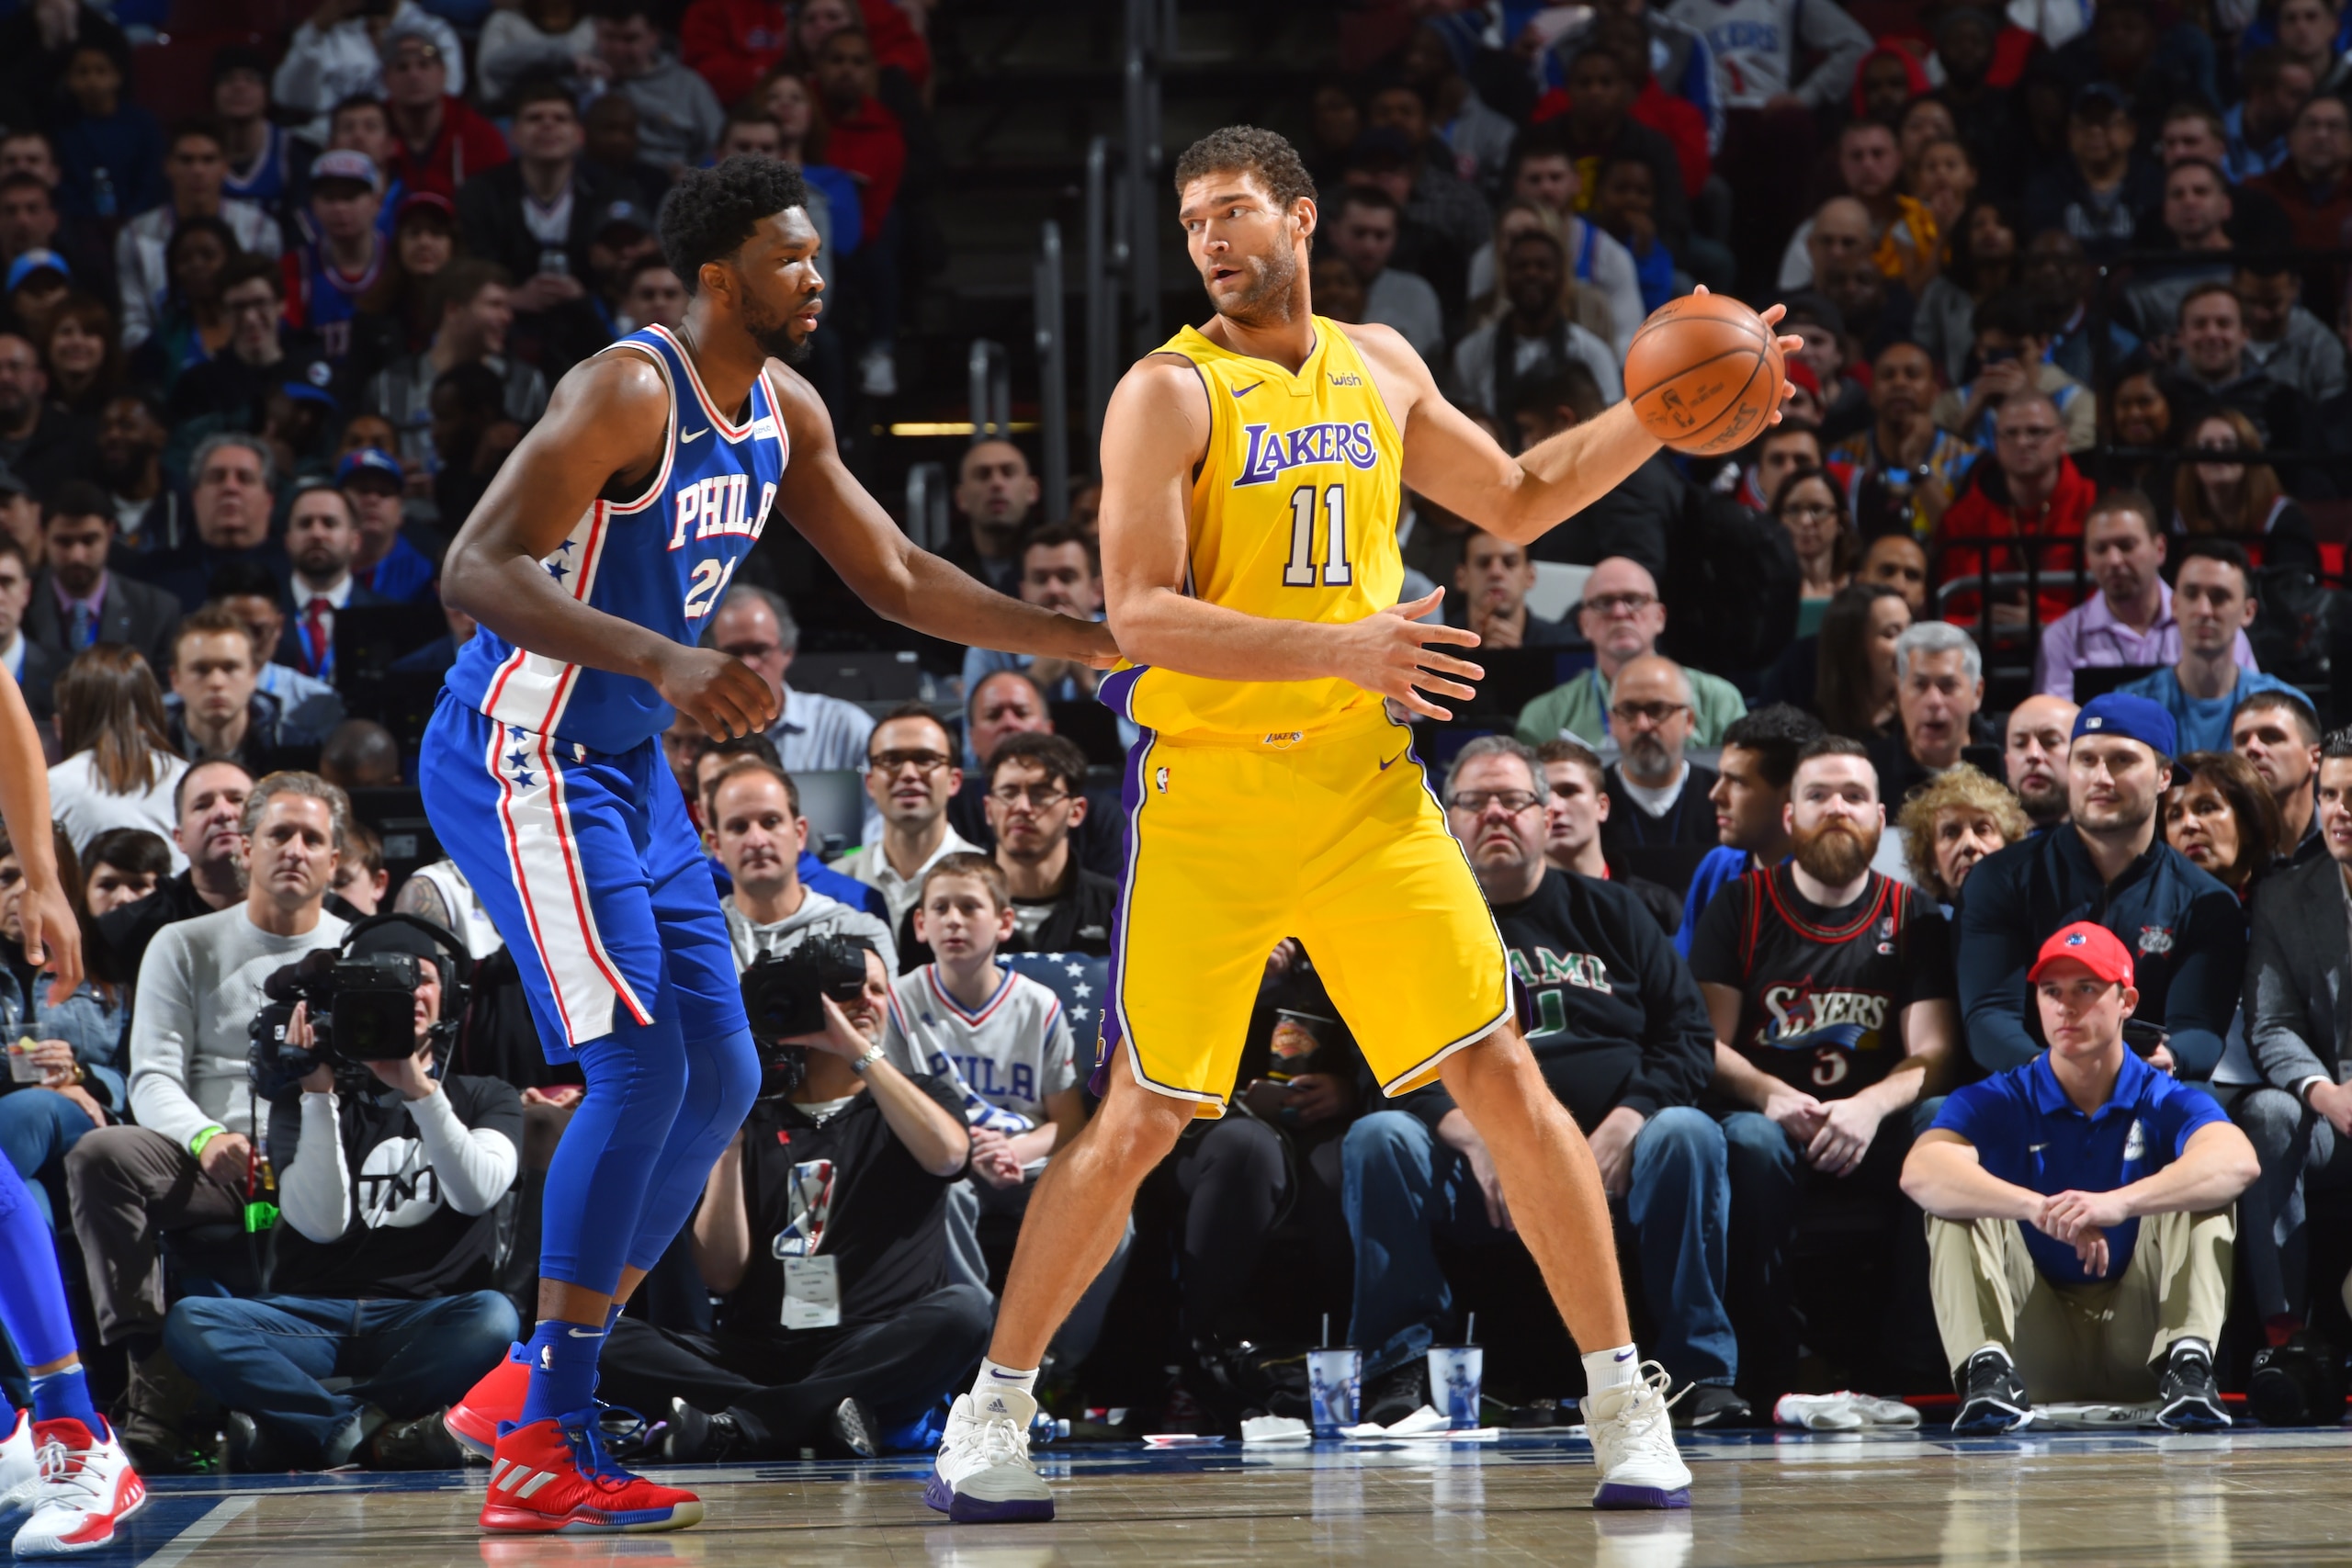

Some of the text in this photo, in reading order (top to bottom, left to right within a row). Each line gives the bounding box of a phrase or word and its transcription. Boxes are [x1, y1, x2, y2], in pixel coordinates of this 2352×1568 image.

[1327, 372, 1362, 387] wish
[1232, 422, 1379, 490] LAKERS
[1283, 484, 1352, 588] 11
[1262, 730, 1305, 744] LAKERS
[1509, 946, 1612, 994] AMI
[929, 1052, 1035, 1101] PILA
